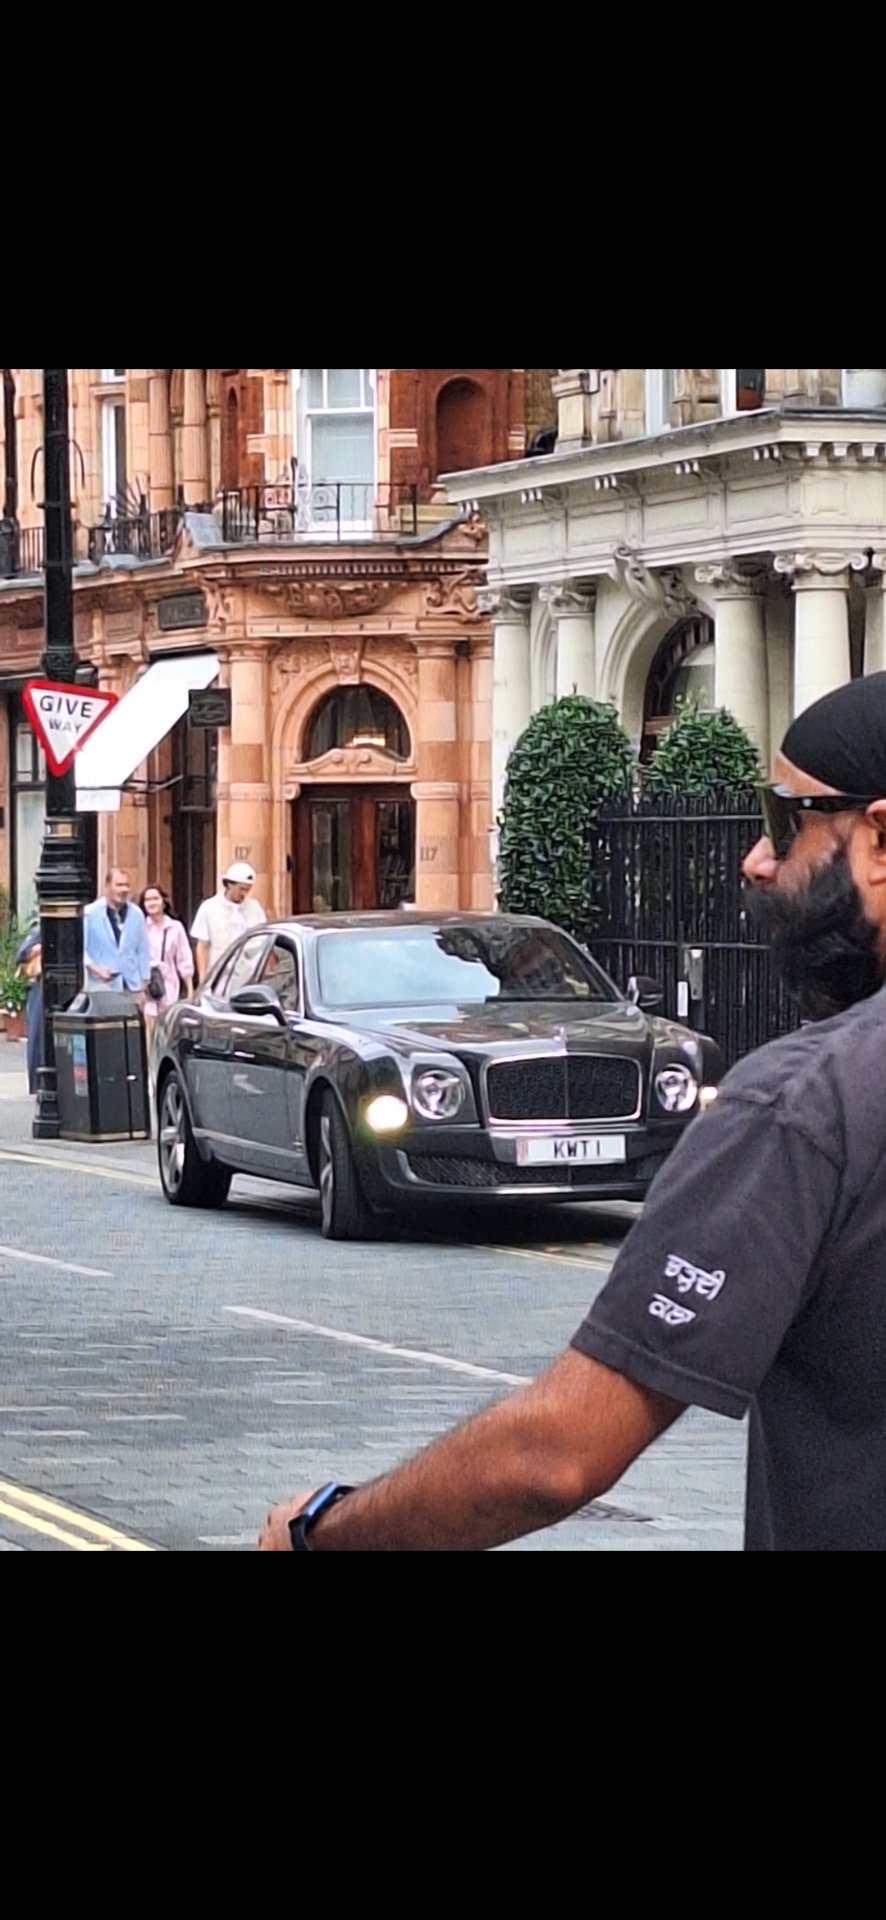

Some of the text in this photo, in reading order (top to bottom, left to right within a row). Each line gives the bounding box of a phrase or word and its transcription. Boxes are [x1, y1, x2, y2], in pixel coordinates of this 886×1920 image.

[40, 695, 94, 718] GIVE
[49, 718, 83, 734] WAY
[420, 846, 438, 861] 117
